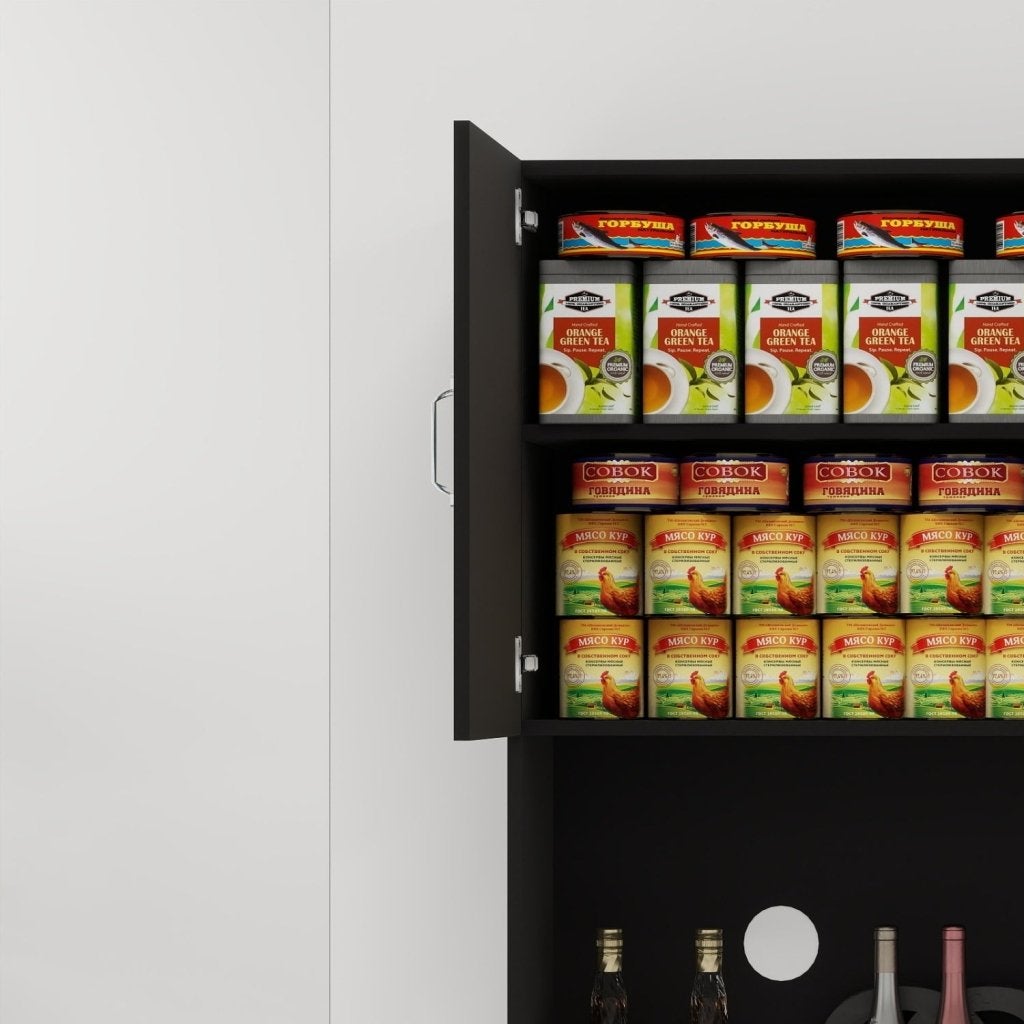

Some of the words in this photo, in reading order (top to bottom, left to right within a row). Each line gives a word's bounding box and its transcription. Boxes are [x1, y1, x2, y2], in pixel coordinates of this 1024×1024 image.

[598, 220, 675, 231] ГОРБУША
[731, 221, 808, 232] ГОРБУША
[880, 219, 957, 230] ГОРБУША
[566, 328, 603, 337] ORANGE
[670, 328, 707, 337] ORANGE
[872, 328, 909, 337] ORANGE
[560, 338, 590, 346] GREEN
[594, 338, 610, 346] TEA
[767, 338, 797, 346] GREEN
[800, 338, 817, 346] TEA
[971, 338, 1001, 346] GREEN
[1004, 338, 1021, 346] TEA
[586, 465, 653, 478] СОВОК
[696, 465, 763, 478] СОВОК
[936, 466, 1003, 479] СОВОК
[588, 487, 650, 496] ГОВЯДИНА
[698, 487, 760, 496] ГОВЯДИНА
[822, 487, 884, 496] ГОВЯДИНА
[575, 531, 606, 542] МЯСО
[609, 531, 628, 541] КУР
[664, 531, 696, 542] МЯСО
[698, 531, 718, 541] КУР
[837, 531, 868, 542] МЯСО
[871, 531, 890, 541] КУР
[921, 531, 952, 542] МЯСО
[955, 531, 974, 541] КУР
[577, 636, 608, 646] МЯСО
[611, 636, 630, 646] КУР
[755, 636, 786, 646] МЯСО
[789, 636, 808, 646] КУР
